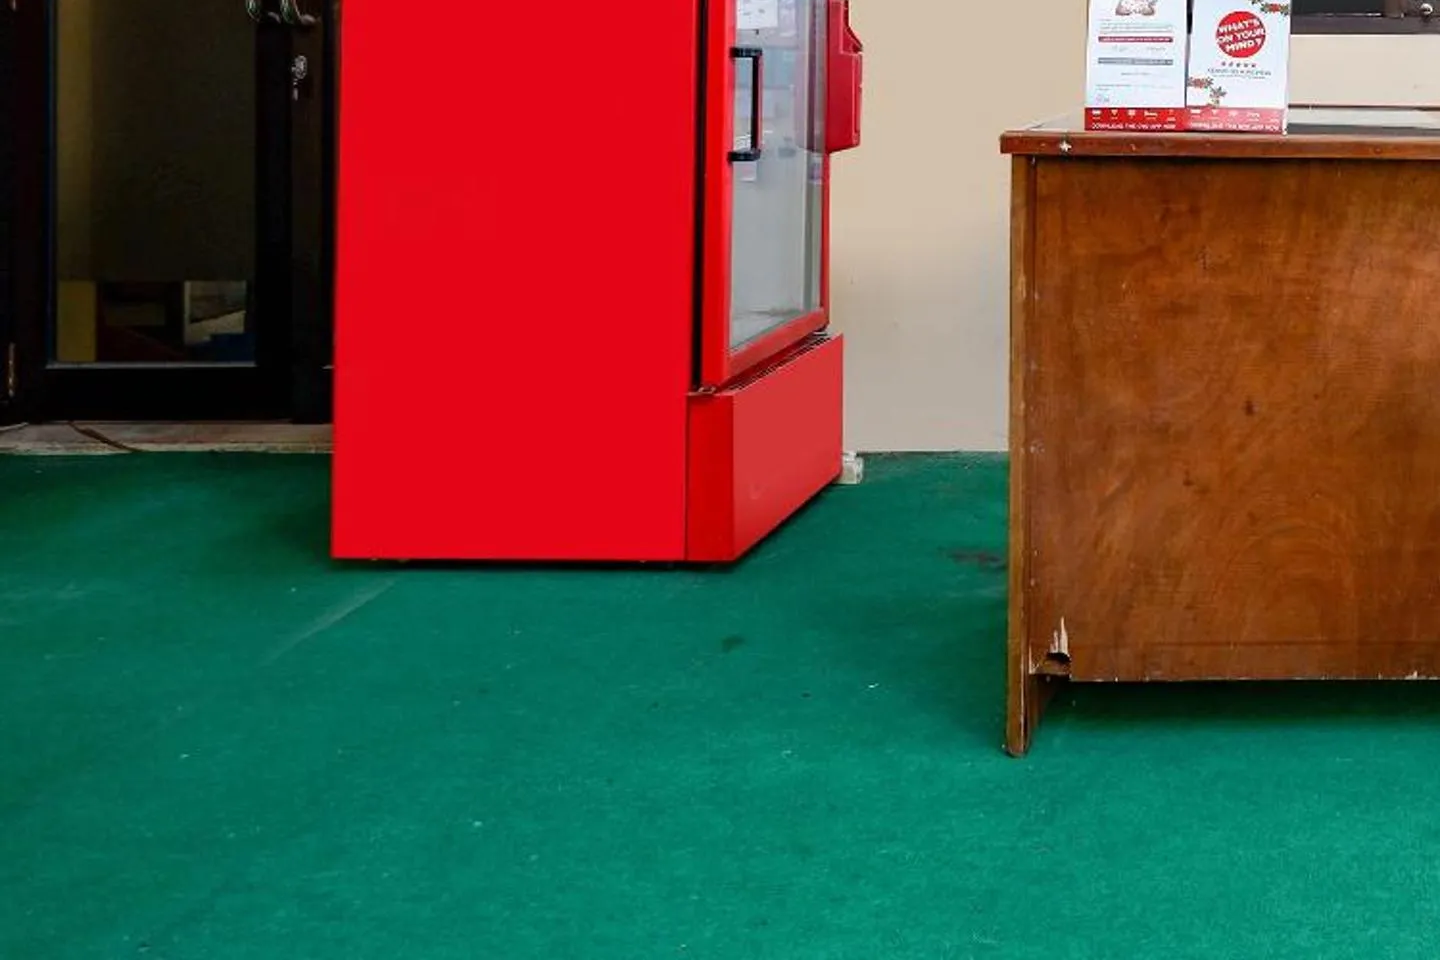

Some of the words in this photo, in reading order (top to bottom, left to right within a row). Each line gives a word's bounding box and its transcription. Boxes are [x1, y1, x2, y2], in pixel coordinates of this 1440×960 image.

[1218, 18, 1260, 33] WHAT'S
[1217, 34, 1233, 44] ON
[1234, 28, 1265, 40] YOUR
